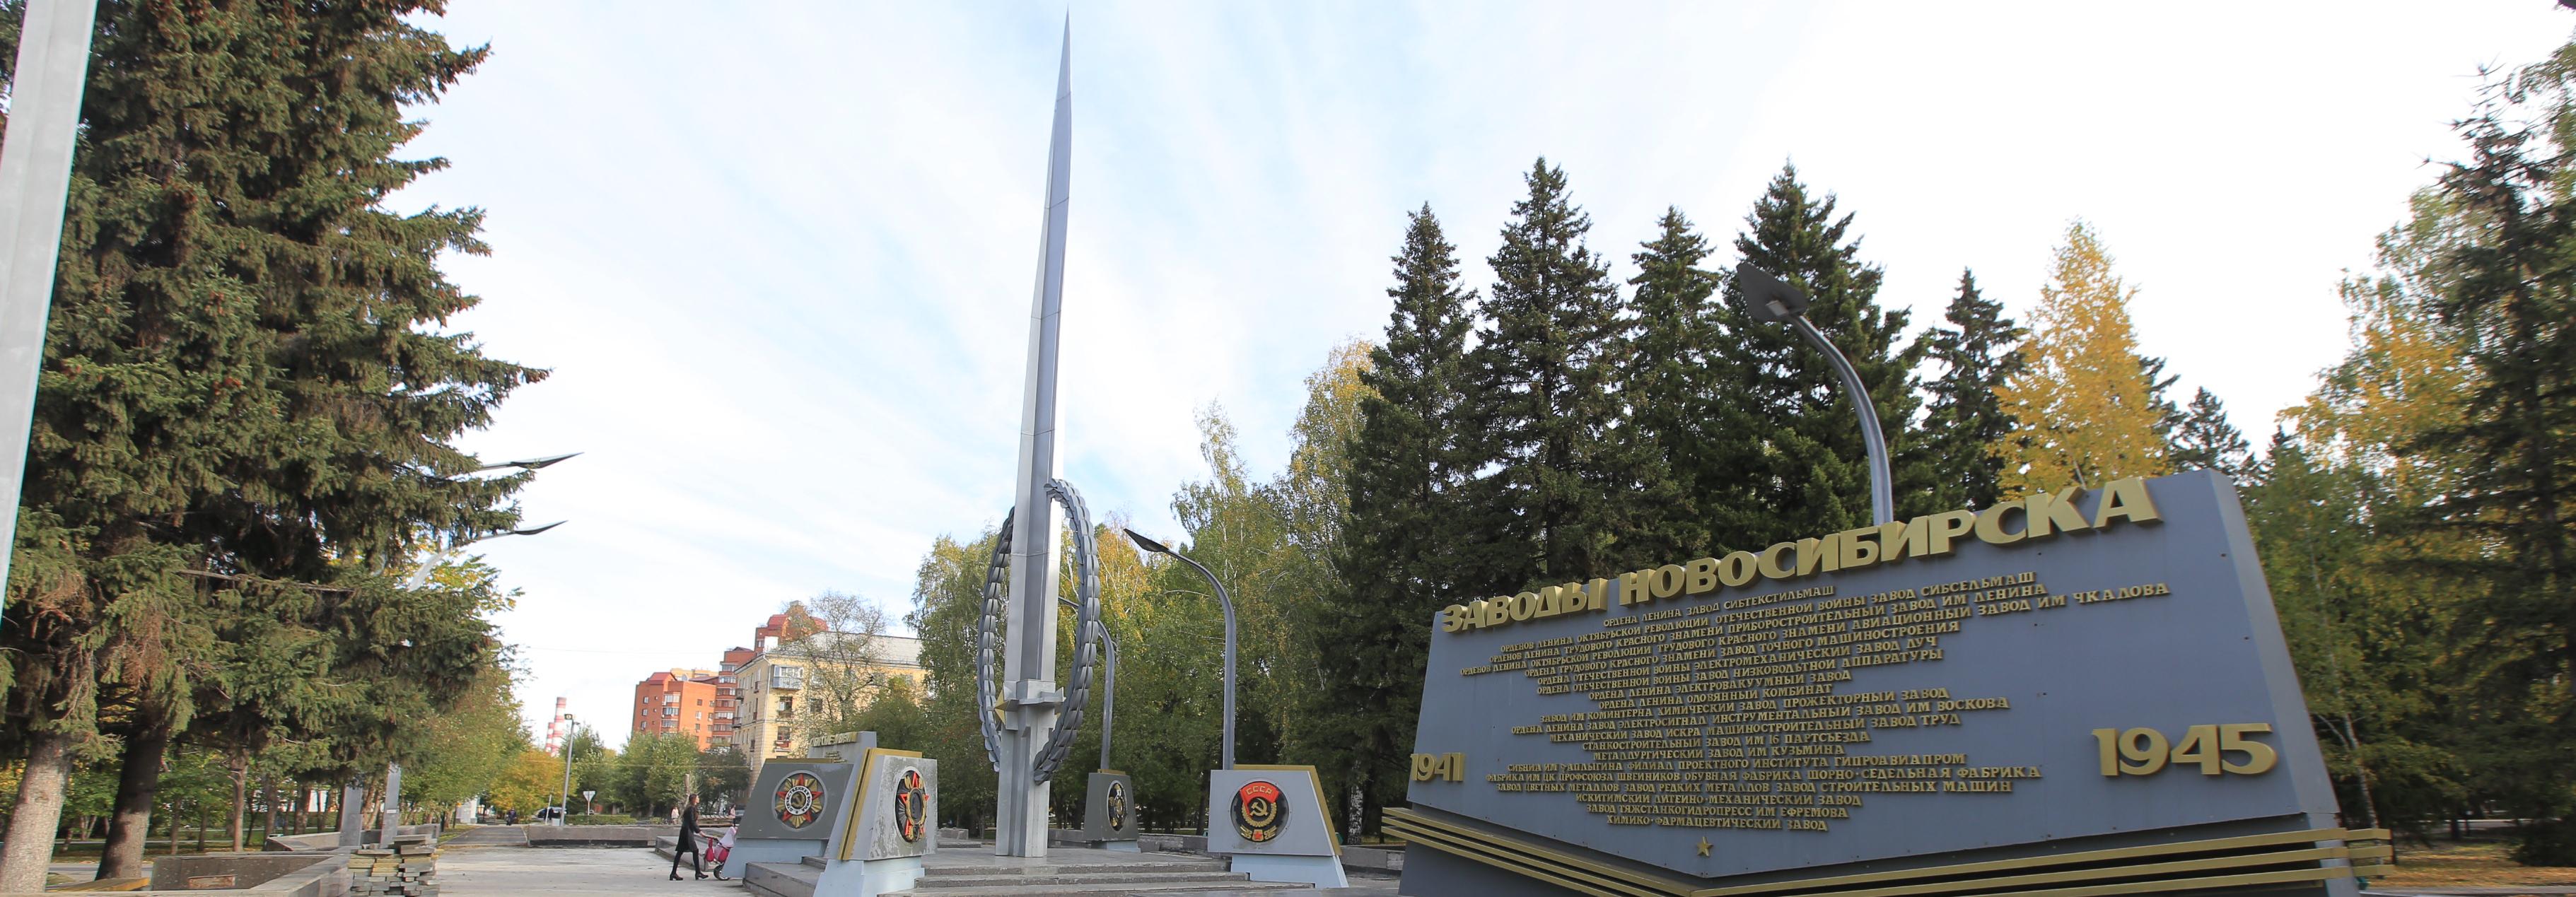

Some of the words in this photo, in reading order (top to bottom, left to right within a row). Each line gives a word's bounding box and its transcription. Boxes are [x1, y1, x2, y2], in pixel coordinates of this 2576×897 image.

[1442, 578, 1607, 633] ЗАВОДЫ
[1619, 477, 2162, 606] НОВОСИБИРСКА
[1500, 640, 1534, 652] ОРДЕНОВ
[1537, 635, 1573, 647] ЛЕНИНА
[1644, 617, 1709, 634] РЕВОЛЮЦИИ
[1870, 588, 1916, 604] ЗАВОД
[1921, 570, 2036, 597] СИБСЕЛЬМАШ
[1603, 614, 1638, 628] ОРДЕНА
[1641, 608, 1682, 622] ЛЕНИНА
[1686, 602, 1720, 616] ЗАВОД
[1724, 585, 1834, 610] СИБТЕКСТИЛЬМАШ
[1459, 665, 1491, 676] ОРДЕНОВ
[1493, 661, 1527, 672] ЛЕНИНА
[1592, 645, 1653, 661] РЕВОЛЮЦИИ
[1657, 638, 1715, 653] ТРУДОВОГО
[1718, 630, 1778, 646] КРАСНОГО
[1782, 621, 1846, 638] ЗНАМЕНИ
[1977, 599, 2032, 616] ЗАВОД
[2037, 594, 2067, 609] ИМ
[2072, 582, 2172, 604] ЧКАЛОВА
[1488, 652, 1522, 664] ОРДЕНОВ
[1525, 647, 1560, 659] ЛЕНИНА
[1563, 640, 1613, 655] ТРУДОВОГО
[1616, 633, 1666, 647] КРАСНОГО
[1669, 626, 1723, 641] ЗНАМЕНИ
[1891, 597, 1937, 614] ЗАВОД
[1942, 594, 1967, 607] ИМ
[1974, 583, 2048, 603] ЛЕНИНА
[1524, 666, 1556, 677] ОРДЕНА
[1558, 660, 1607, 674] ТРУДОВОГО
[1610, 655, 1659, 668] КРАСНОГО
[1662, 648, 1716, 662] ЗНАМЕНИ
[1719, 644, 1756, 657] ЗАВОД
[1760, 638, 1814, 652] ТОЧНОГО
[1817, 621, 1960, 646] МАШИНОСТРОЕНИЯ
[1537, 674, 1569, 686] ОРДЕНА
[1858, 640, 1900, 654] ЗАВОД
[1908, 635, 1937, 649] ЛУЧ
[1537, 684, 1569, 695] ОРДЕНА
[1694, 669, 1729, 681] ЗАВОД
[1842, 649, 1942, 668] АППАРАТУРЫ
[1589, 689, 1624, 700] ОРДЕНА
[1629, 685, 1672, 697] ЛЕНИНА
[1811, 670, 1851, 683] ЗАВОД
[1539, 713, 1568, 723] ЗАВОД
[1571, 713, 1586, 721] ИМ
[1588, 708, 1653, 720] КОМИНТЕРНА
[1741, 700, 1776, 711] ЗАВОД
[1902, 687, 1950, 700] ЗАВОД
[1599, 699, 1634, 710] ОРДЕНА
[1640, 696, 1683, 707] ЛЕНИНА
[1763, 684, 1832, 698] КОМБИНАТ
[1512, 725, 1542, 734] ОРДЕНА
[1546, 722, 1584, 732] ЛЕНИНА
[1586, 721, 1616, 731] ЗАВОД
[1618, 716, 1706, 729] ЭЛЕКТРОСИГНАЛ
[1858, 704, 1901, 716] ЗАВОД
[1907, 702, 1930, 714] ИМ
[1937, 697, 2008, 712] ВОСКОВА
[1632, 729, 1663, 739] ЗАВОД
[1667, 727, 1701, 737] ИСКРА
[1872, 716, 1916, 728] ЗАВОД
[1923, 714, 1960, 726] ТРУД
[1707, 737, 1740, 747] ЗАВОД
[1746, 736, 1765, 746] ИМ
[1768, 735, 1780, 744] 16
[1785, 731, 1869, 744] ПАРТСЪЕЗДА
[1709, 748, 1743, 758] ЗАВОД
[1748, 747, 1767, 757] ИМ
[1771, 745, 1844, 756] КУЗЬМИНА
[2091, 722, 2277, 776] 1945
[1410, 753, 1464, 782] 1941
[1527, 773, 1540, 782] ИМ
[1558, 773, 1614, 781] ПРОФСОЮЗА
[1684, 771, 1738, 781] ОБУВНАЯ
[1742, 770, 1802, 780] ФАБРИКА
[1957, 766, 2042, 778] ФАБРИКА
[1628, 761, 1674, 770] ФИЛИАЛ
[1679, 759, 1750, 770] ПРОЕКТНОГО
[1754, 757, 1828, 768] ИНСТИТУТА
[1834, 754, 1965, 767] ГИПРОАВИАПРОМ
[1246, 785, 1273, 795] СССР
[1568, 784, 1620, 792] МЕТАЛЛОВ
[1623, 784, 1655, 792] ЗАВОД
[1659, 784, 1701, 792] РЕДКИХ
[1704, 783, 1771, 792] МЕТАЛЛОВ
[1776, 783, 1816, 792] ЗАВОД
[1820, 782, 1937, 792] СТРОИТЕЛЬНЫХ
[1942, 781, 2013, 792] МАШИН
[1819, 795, 1861, 806] ЗАВОД
[1585, 804, 1616, 813] ЗАВОД
[1619, 805, 1751, 816] ТЯЖСТАНКОГИДРОПРЕСС
[1756, 807, 1776, 816] ИМ
[1780, 807, 1848, 818] ЕФРЕМОВА
[1787, 820, 1827, 831] ЗАВОД
